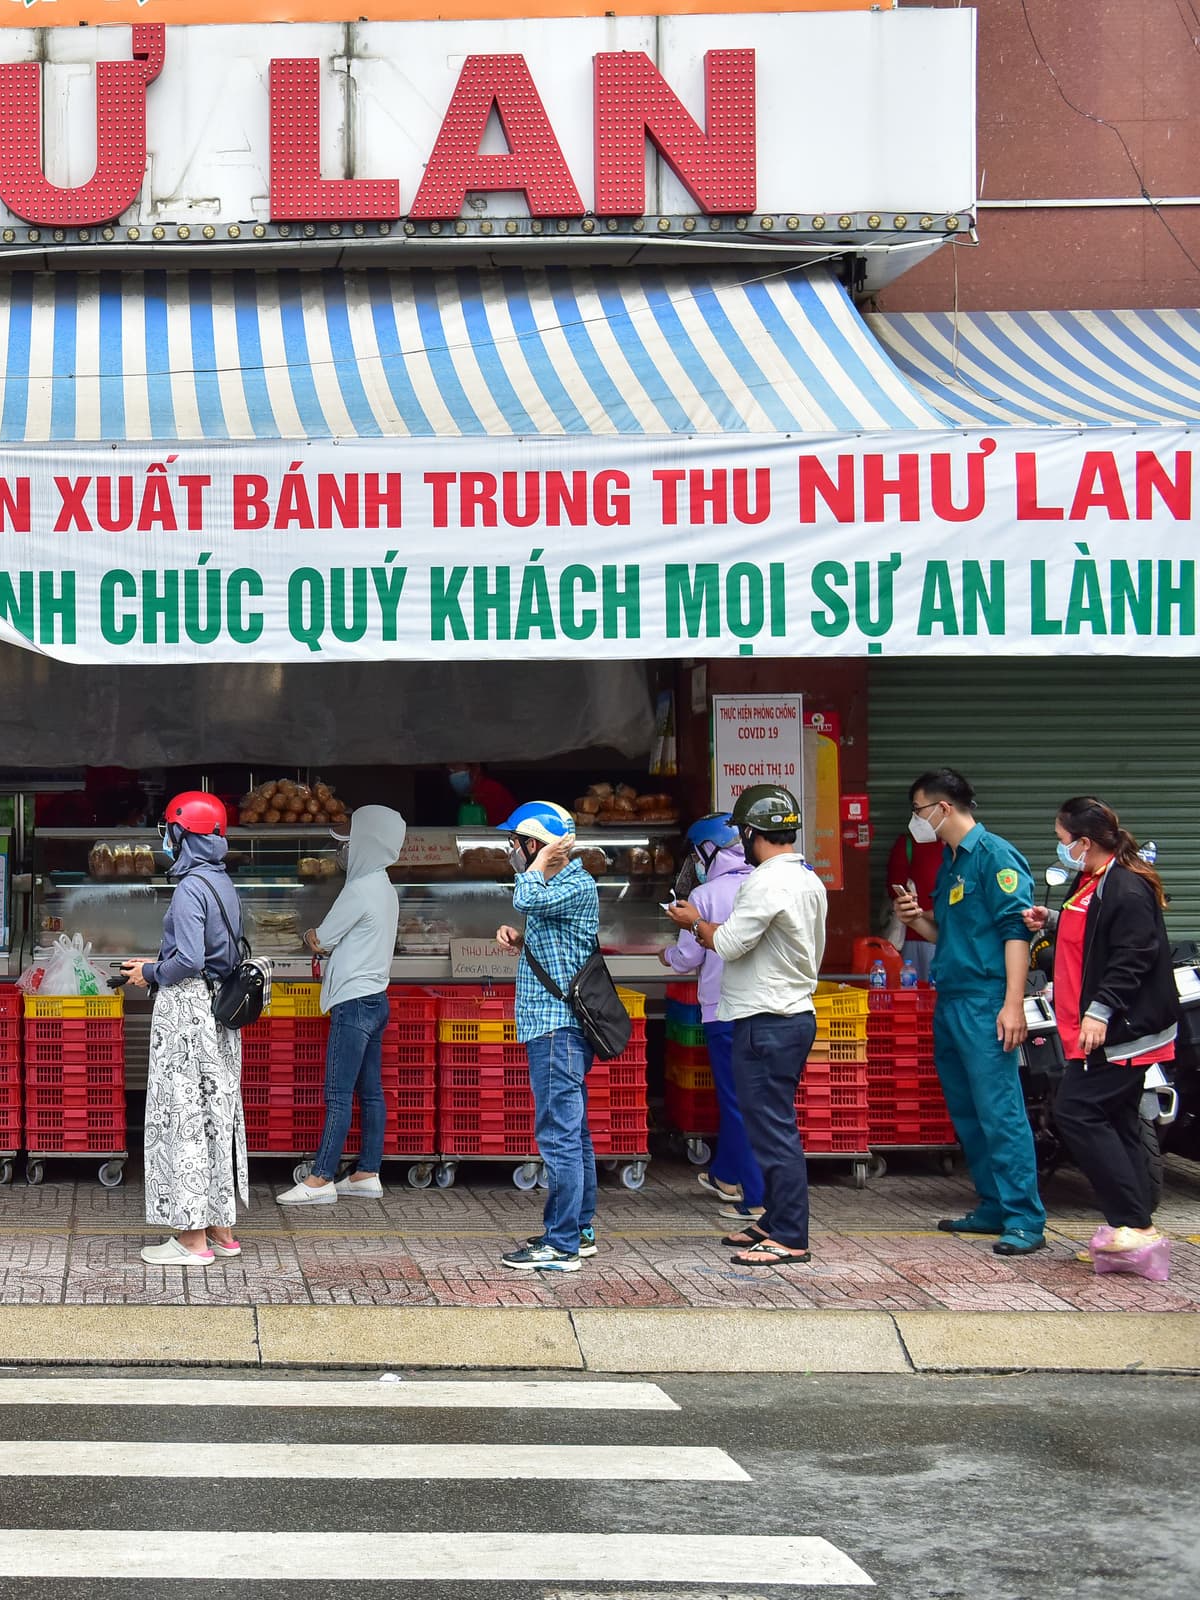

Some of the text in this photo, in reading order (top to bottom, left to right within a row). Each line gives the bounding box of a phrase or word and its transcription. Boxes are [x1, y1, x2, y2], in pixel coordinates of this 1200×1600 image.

[269, 49, 757, 221] LAN
[53, 454, 211, 532] XUẤT
[233, 460, 402, 530] BÁNH
[423, 470, 631, 528] TRUNG
[652, 468, 771, 525] THU
[800, 437, 997, 523] NHƯ
[1016, 450, 1192, 521] LAN
[100, 552, 264, 645] CHÚC
[288, 549, 407, 652] QUÝ
[430, 548, 641, 641] KHÁCH
[665, 562, 786, 656] MỌI
[811, 552, 902, 655] SỰ
[917, 559, 1006, 636] AN
[1030, 542, 1195, 636] LÀNH
[738, 703, 753, 723] HIỆN
[738, 726, 779, 740] COVID 19
[723, 760, 795, 778] THEO CHỈ THỊ 10
